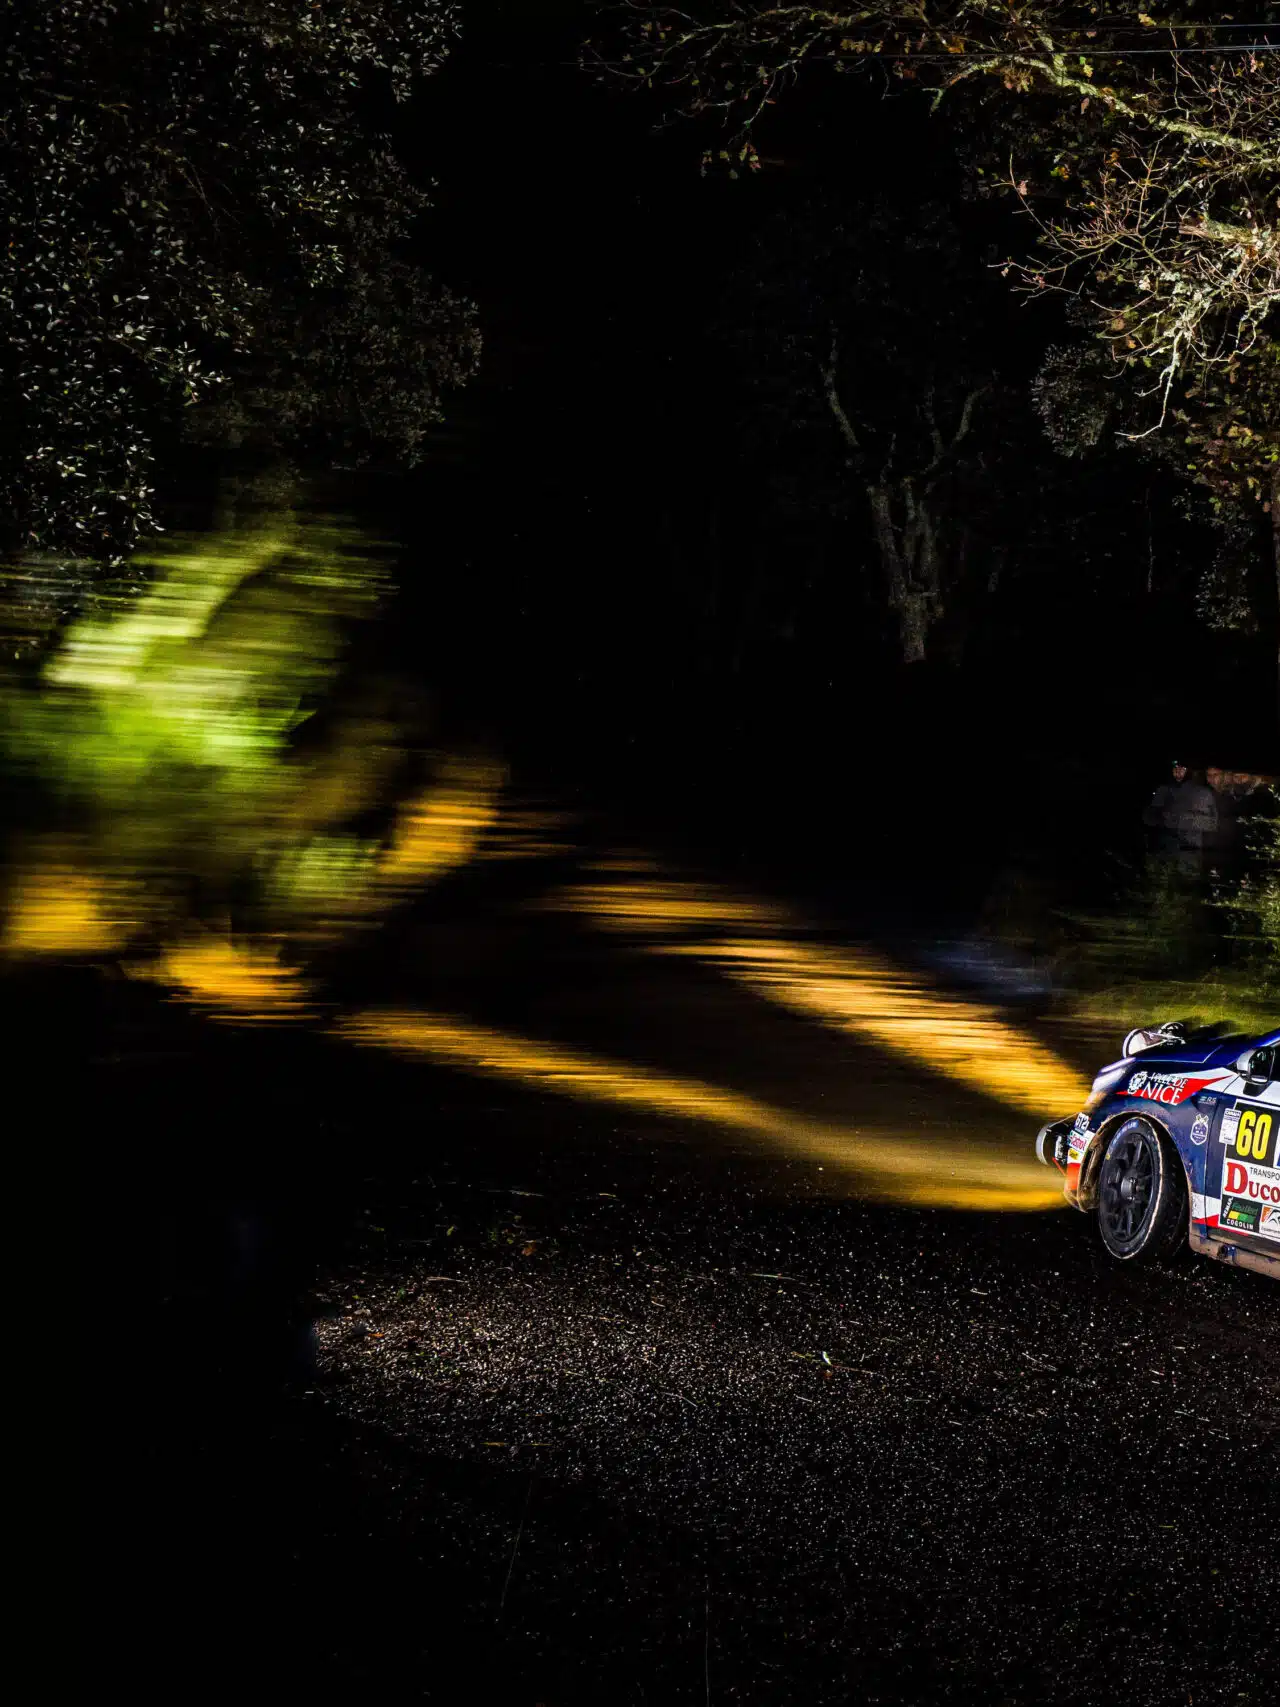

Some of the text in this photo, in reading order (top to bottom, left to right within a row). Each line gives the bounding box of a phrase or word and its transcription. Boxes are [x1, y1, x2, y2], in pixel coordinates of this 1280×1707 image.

[1173, 1077, 1188, 1089] DE
[1140, 1084, 1183, 1106] NICE
[1235, 1110, 1273, 1160] 60
